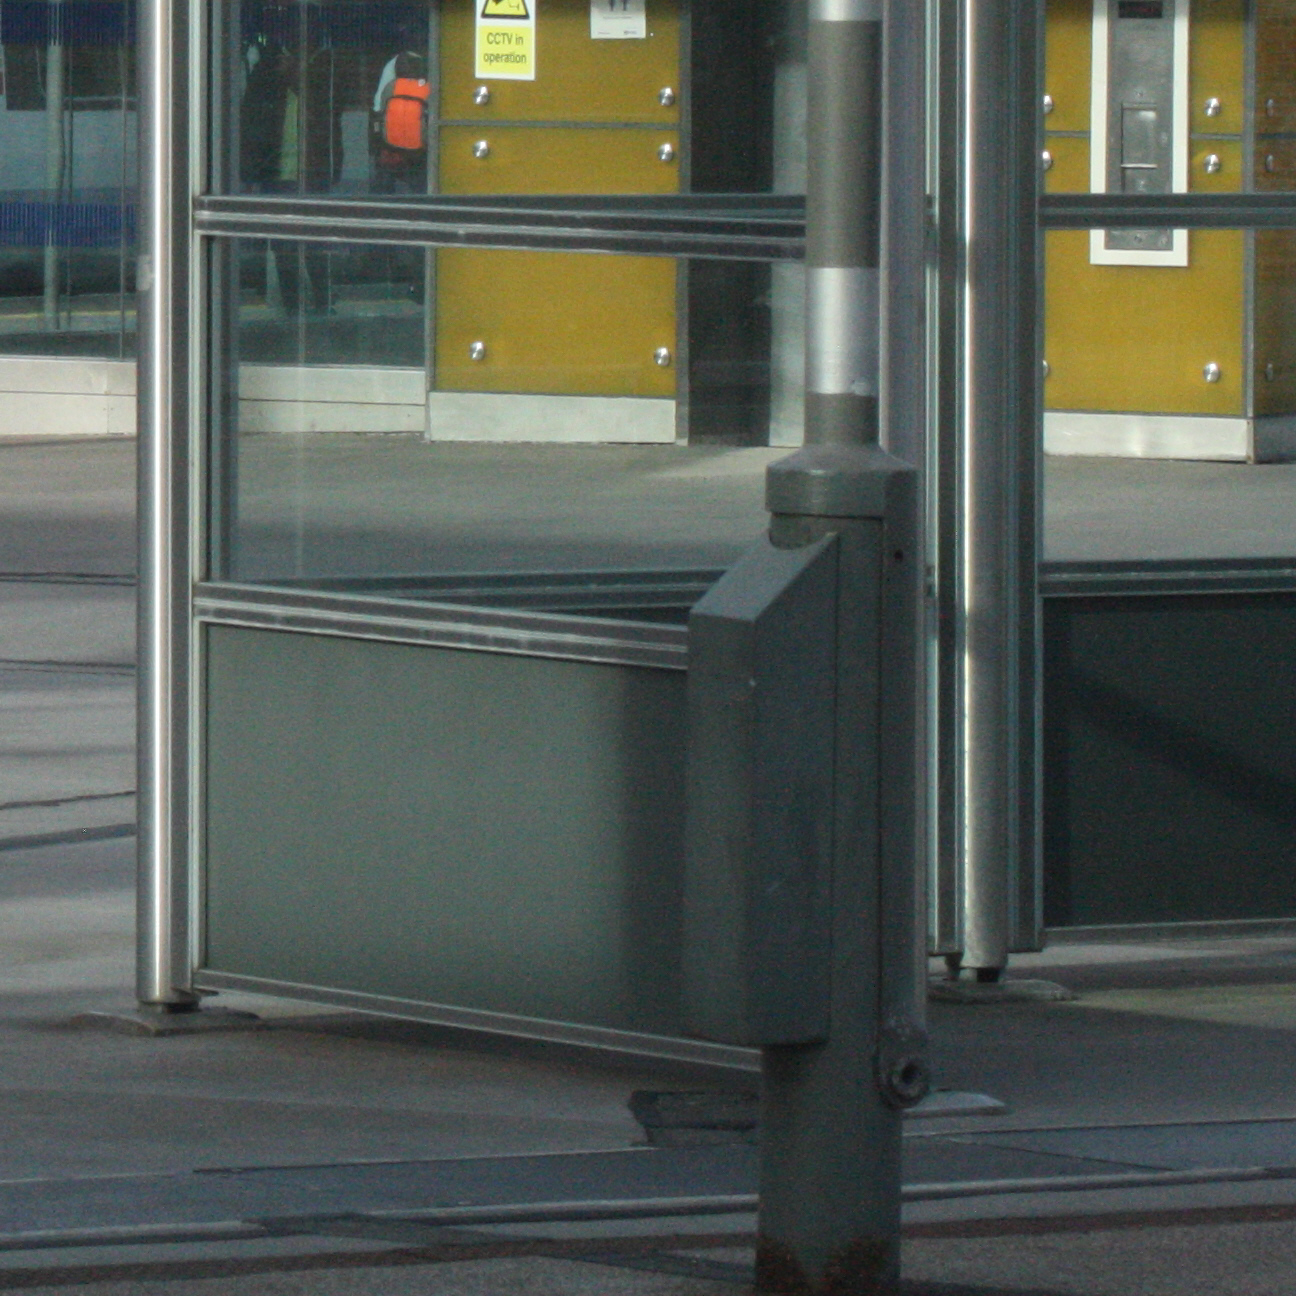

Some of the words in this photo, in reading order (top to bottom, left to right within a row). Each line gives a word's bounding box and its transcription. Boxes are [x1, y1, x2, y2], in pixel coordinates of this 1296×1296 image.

[486, 32, 513, 45] CCTV
[515, 34, 524, 45] in
[483, 50, 527, 66] operation
